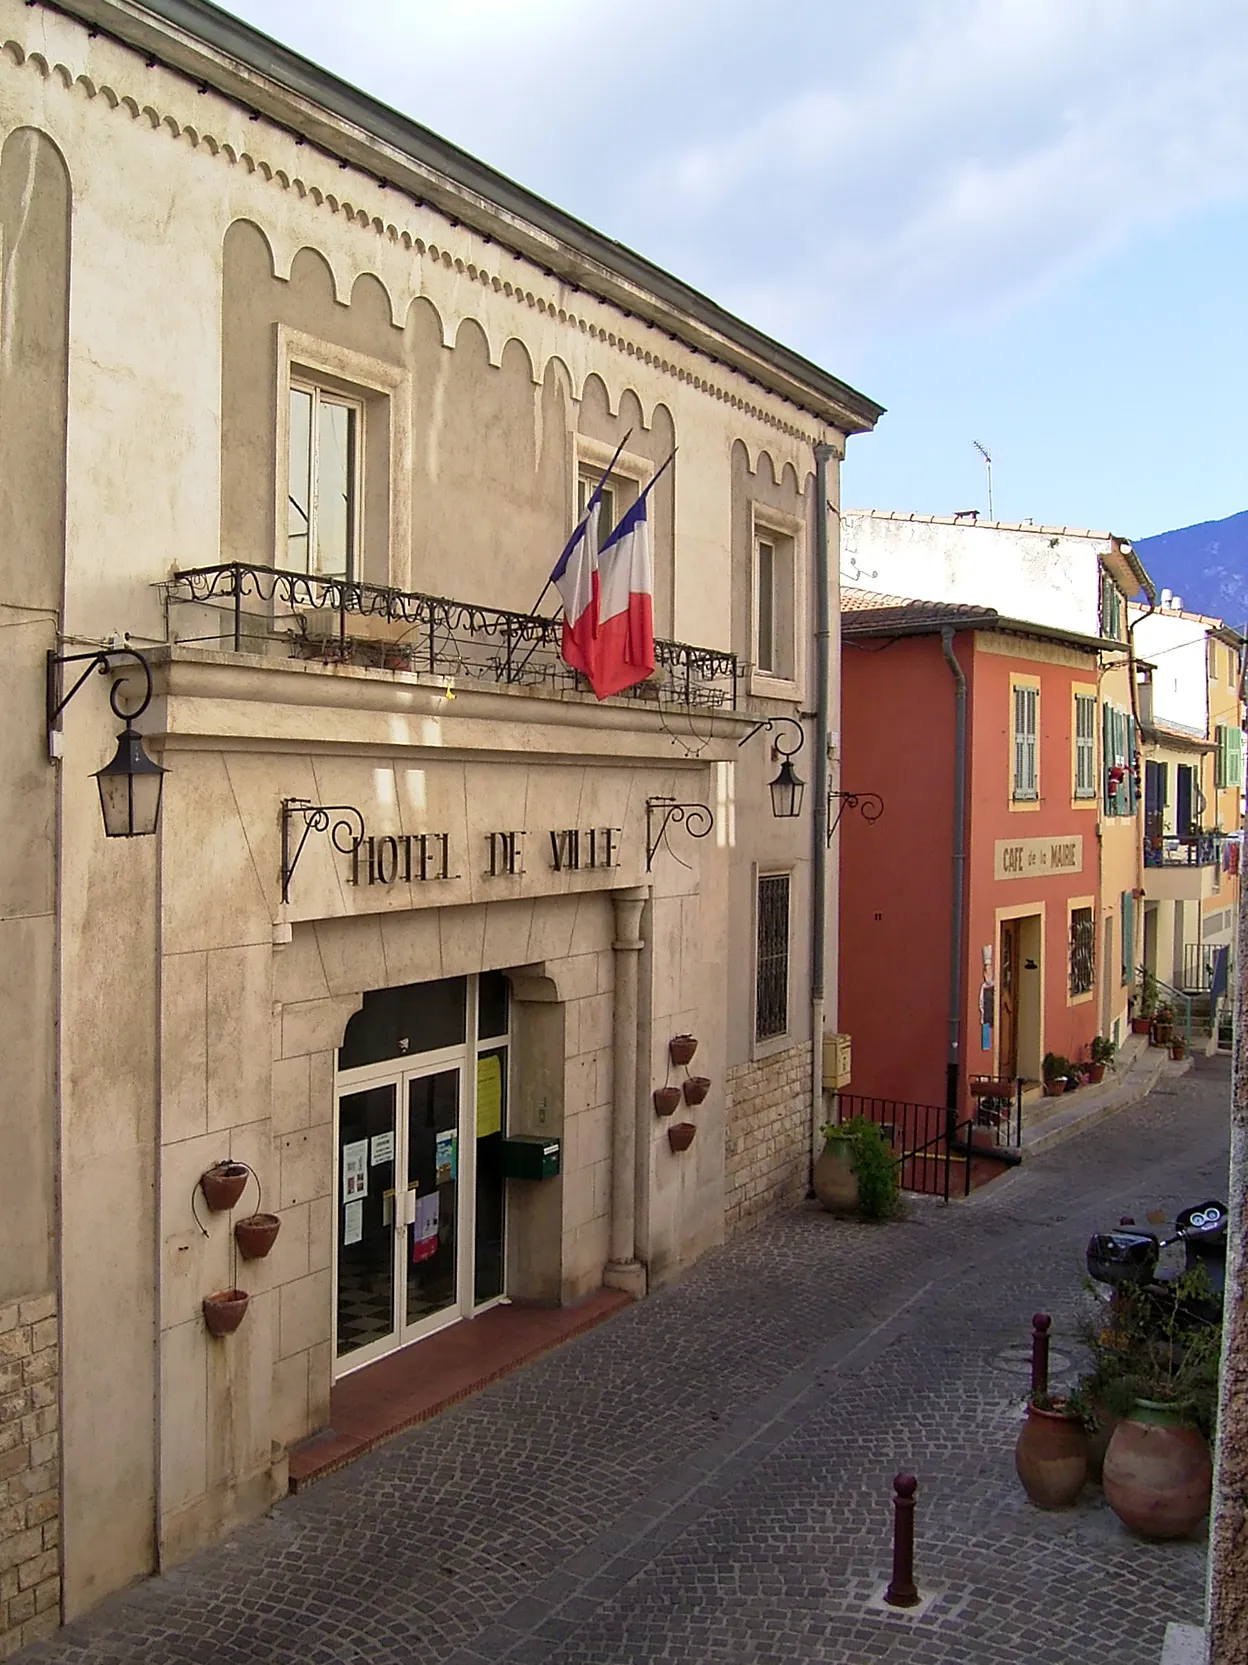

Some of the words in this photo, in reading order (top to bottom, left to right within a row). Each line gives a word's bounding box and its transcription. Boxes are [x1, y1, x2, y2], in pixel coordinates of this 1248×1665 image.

[347, 832, 461, 886] HOTEL
[484, 831, 527, 877] DE
[549, 828, 622, 872] VILLE
[1004, 848, 1024, 872] CAFE
[1028, 851, 1036, 866] de
[1040, 849, 1047, 865] la
[1050, 844, 1076, 868] MAIRIE
